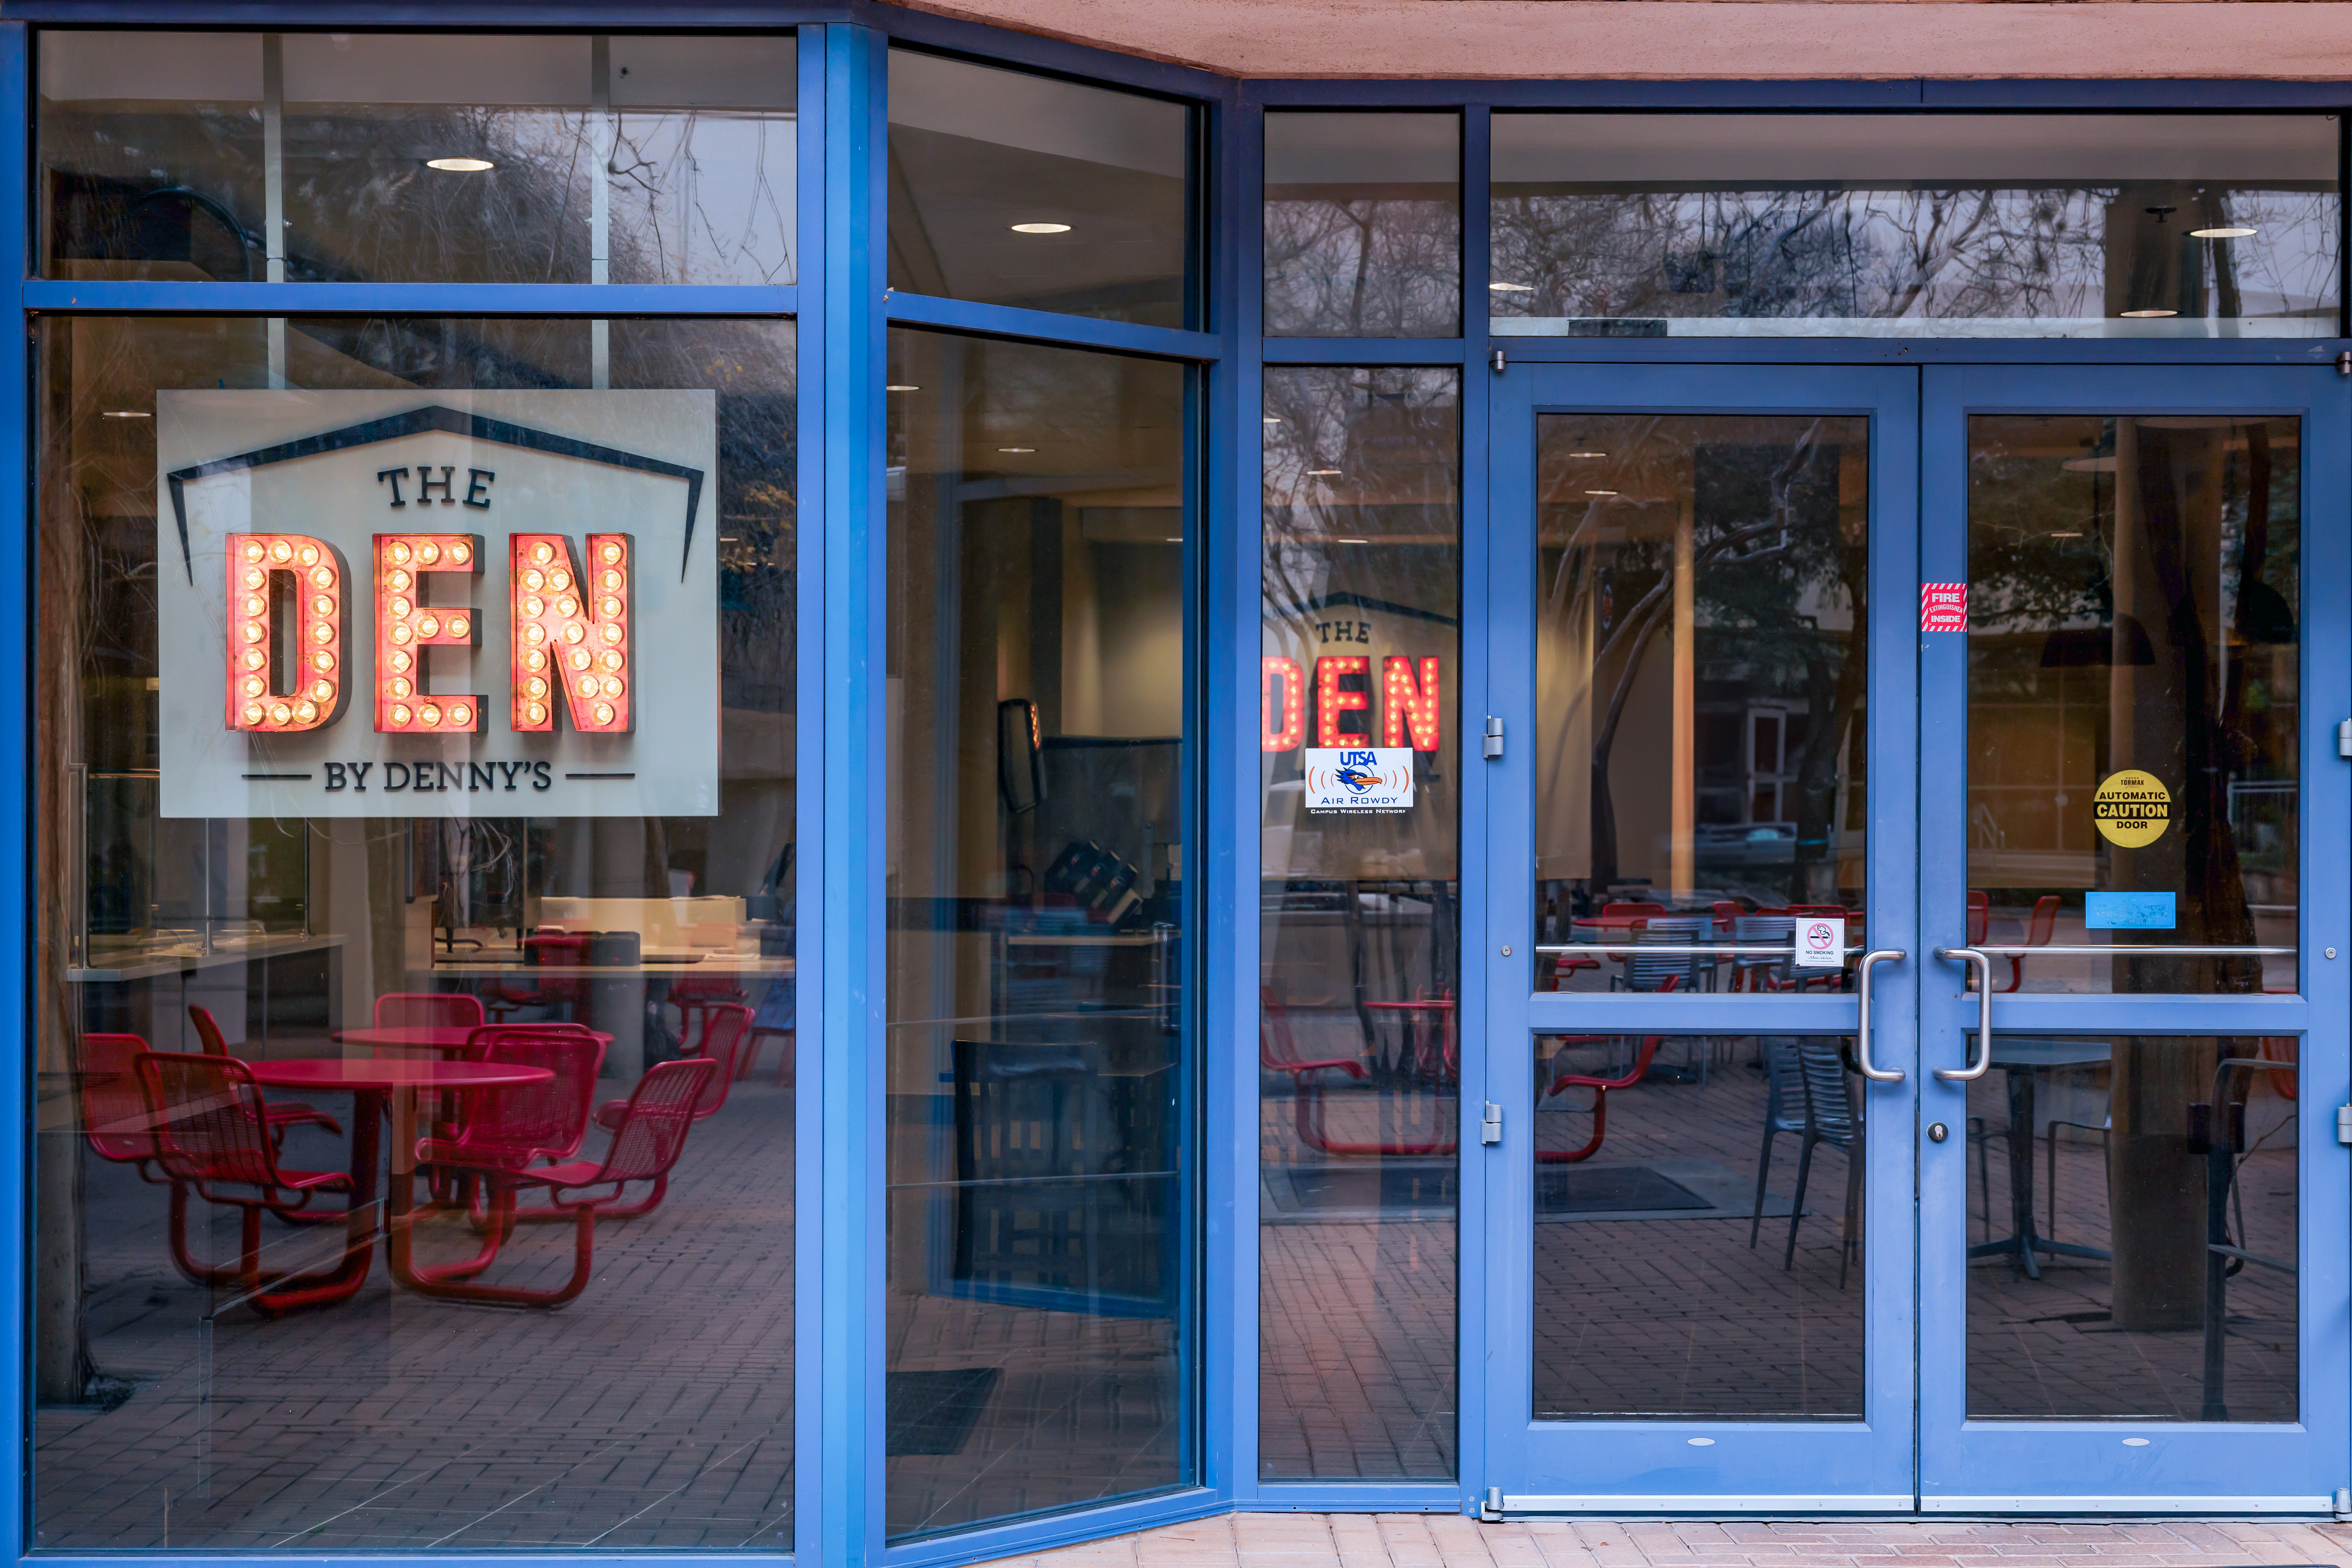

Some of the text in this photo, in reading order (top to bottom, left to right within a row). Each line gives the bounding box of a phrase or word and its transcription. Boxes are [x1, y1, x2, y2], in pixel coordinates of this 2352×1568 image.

[377, 466, 495, 508] THE
[1929, 604, 1963, 614] EXTINGUISHER
[1932, 593, 1960, 602] FIRE
[225, 533, 636, 732] DEN
[1316, 621, 1372, 644] THE
[1262, 655, 1440, 752] DEN
[1340, 751, 1378, 766] UTSA
[324, 761, 552, 790] BY DENNY'S
[2097, 804, 2168, 817] CAUTION
